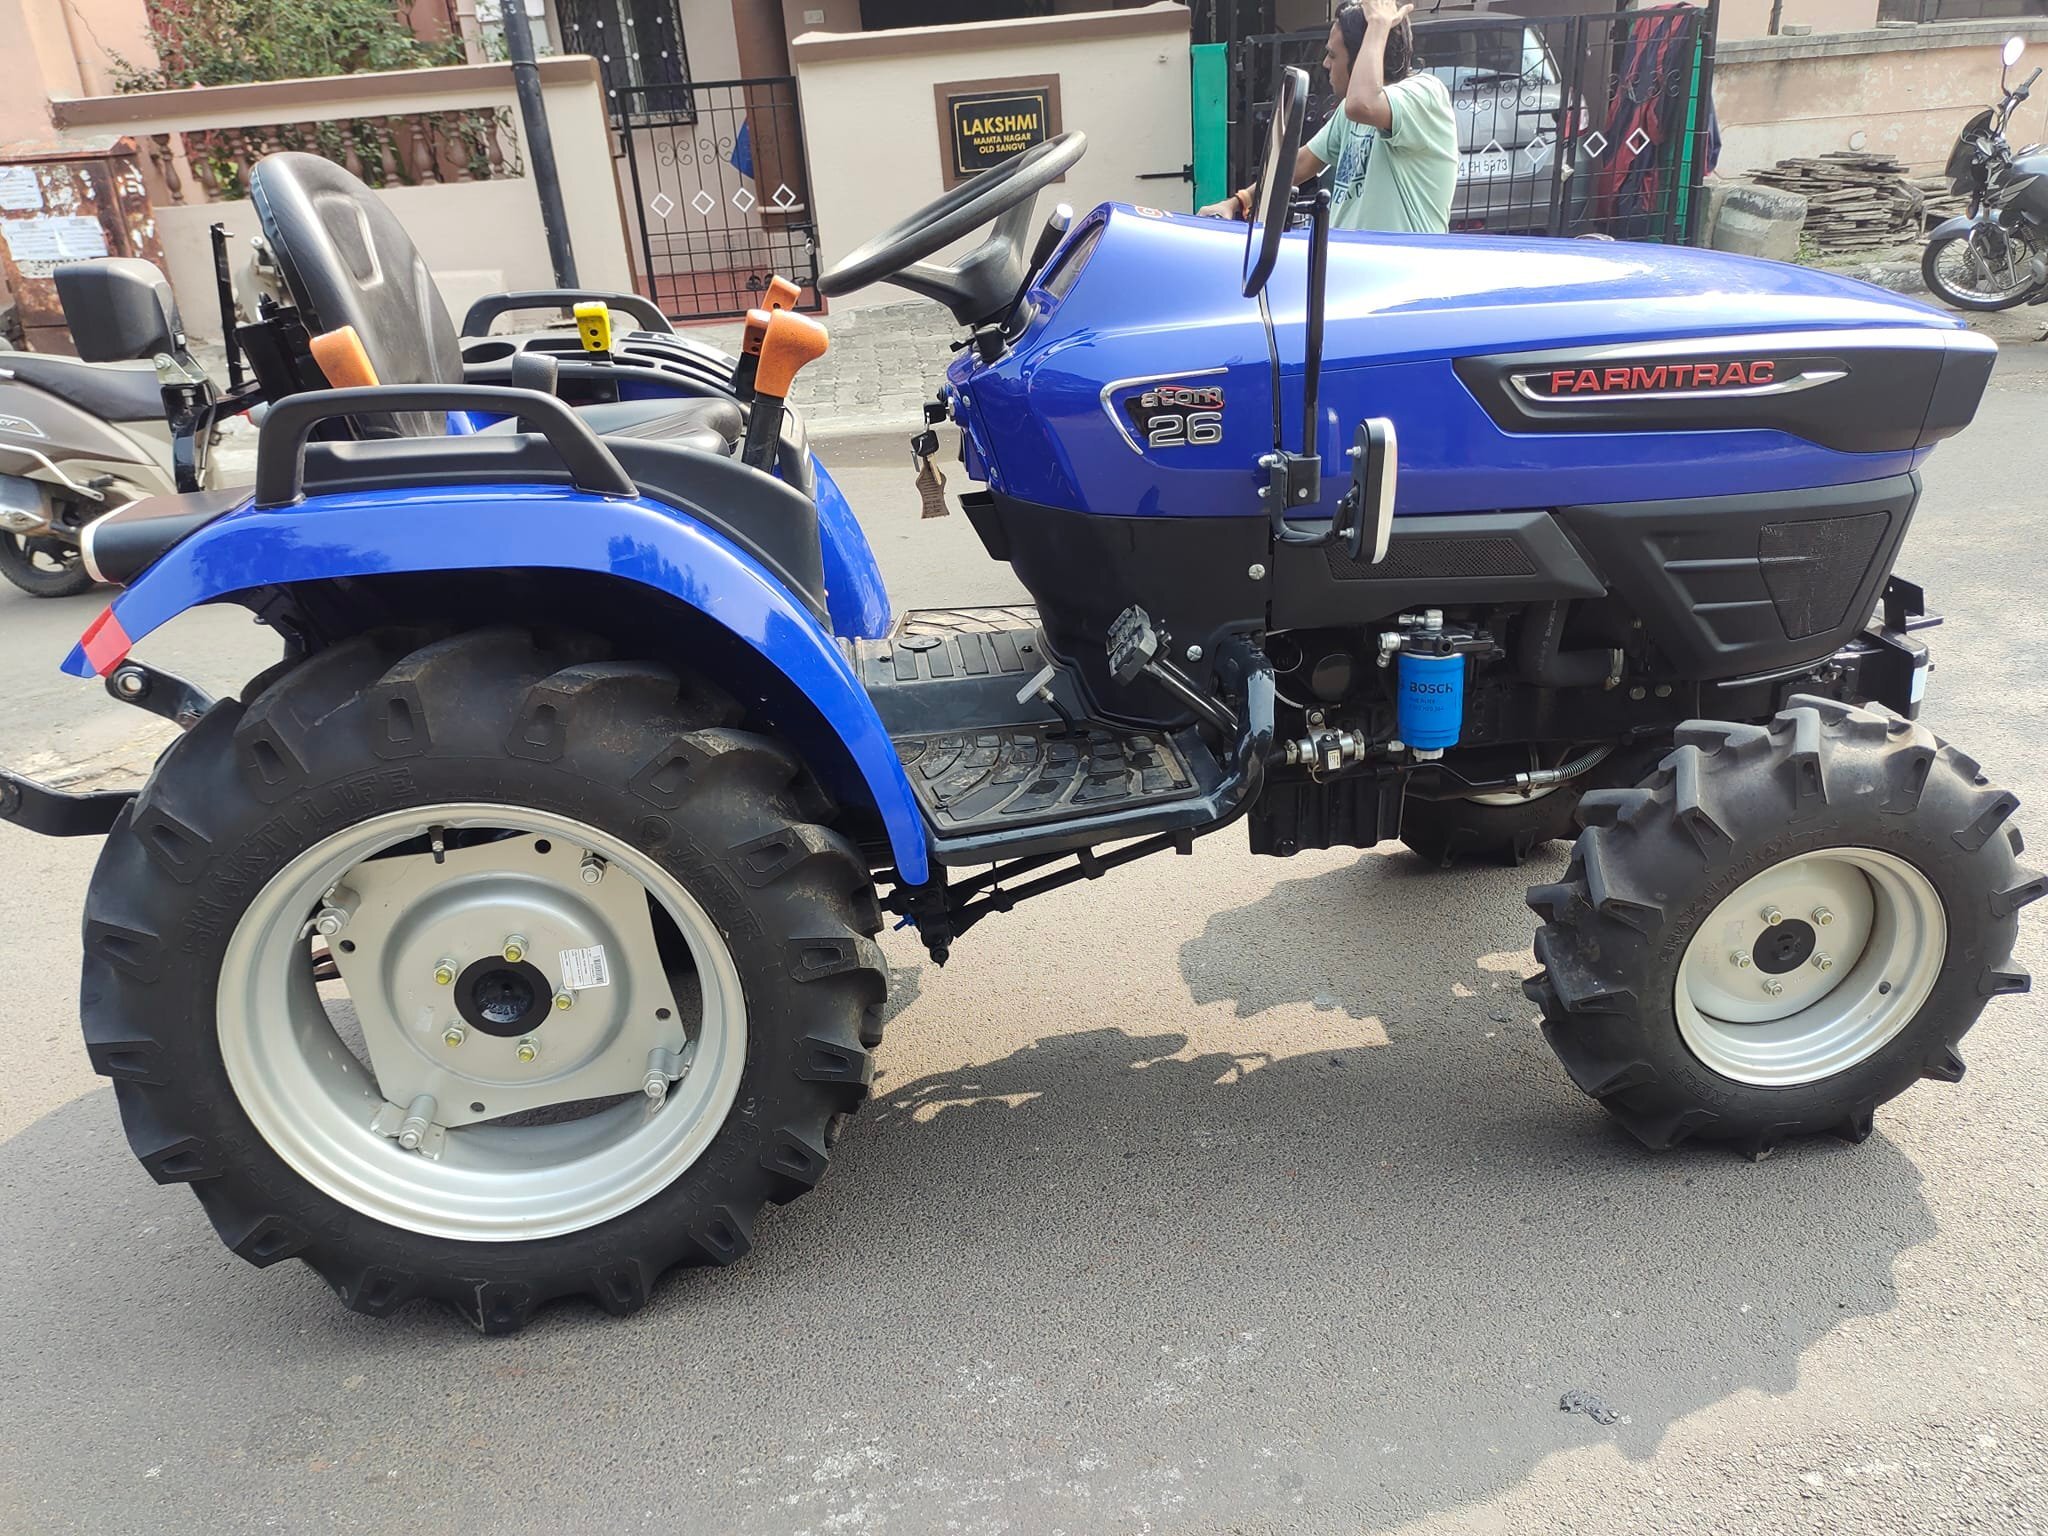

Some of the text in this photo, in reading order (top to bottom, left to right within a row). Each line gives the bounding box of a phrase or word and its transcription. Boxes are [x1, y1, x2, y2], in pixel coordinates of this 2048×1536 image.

[963, 113, 1038, 136] LAKSHMI
[973, 132, 1032, 145] MAMTA NAGAR
[979, 142, 1026, 154] OLD SANGVI
[1550, 360, 1776, 395] FARMTRAC
[1140, 386, 1224, 408] atom
[1147, 411, 1223, 449] 26
[1409, 681, 1454, 695] BOSCH
